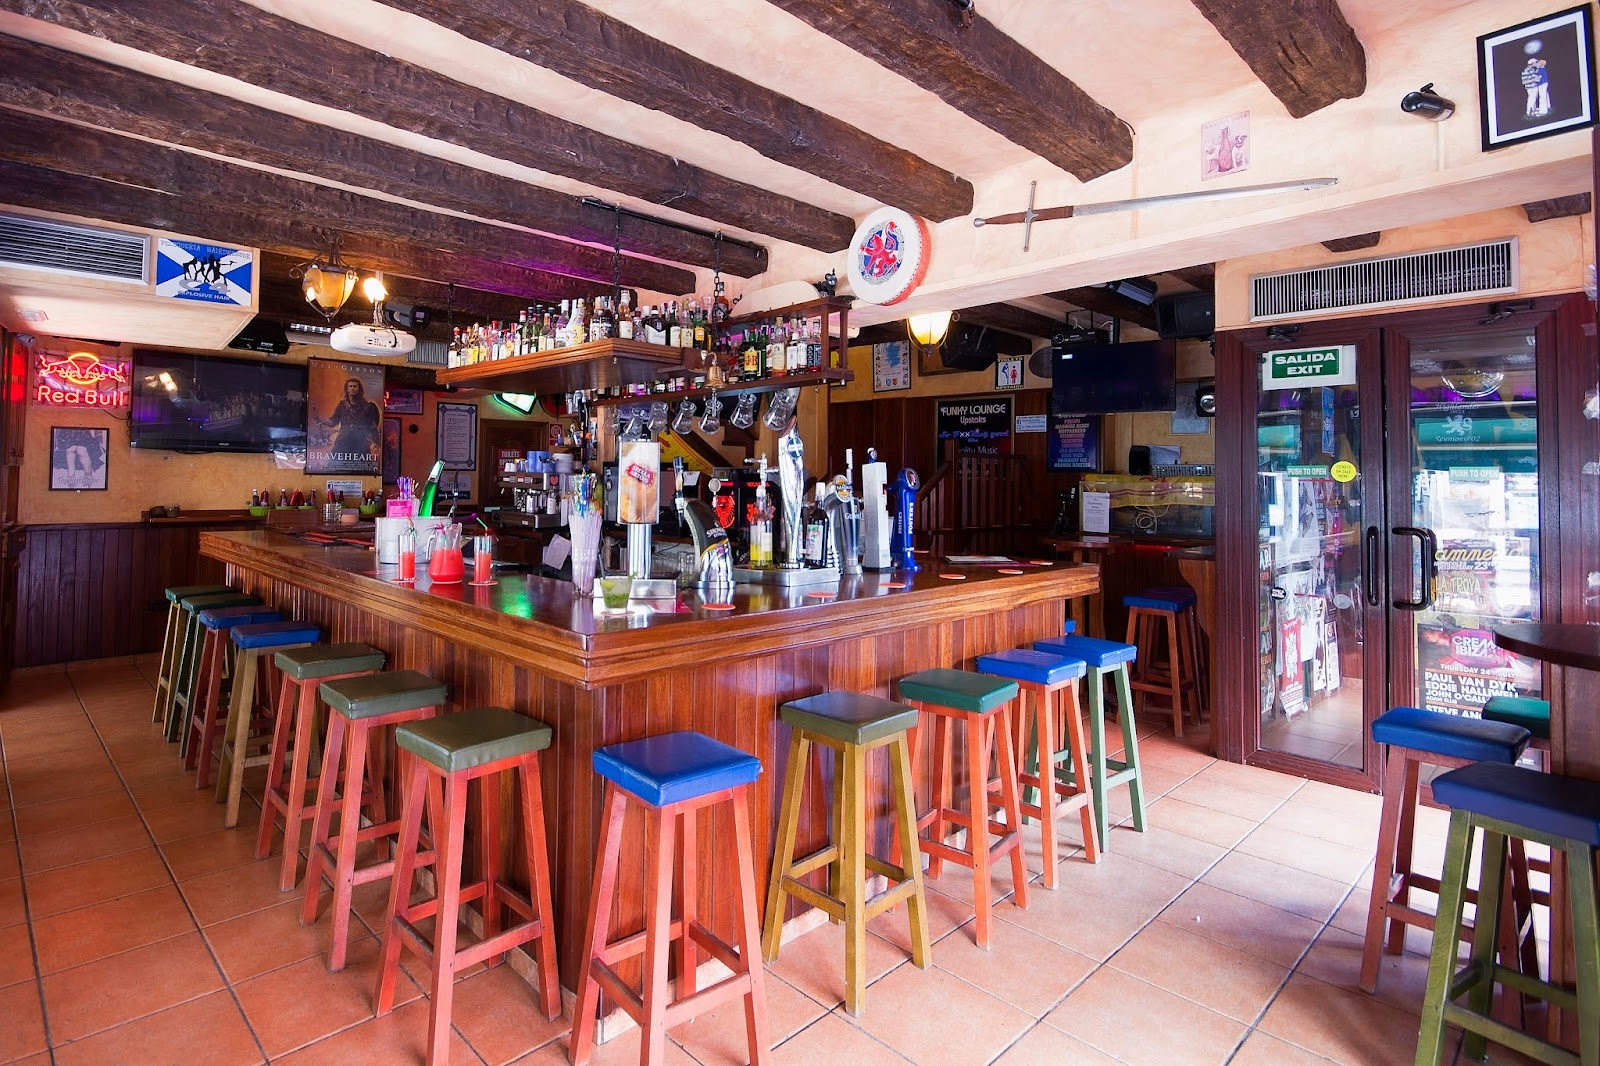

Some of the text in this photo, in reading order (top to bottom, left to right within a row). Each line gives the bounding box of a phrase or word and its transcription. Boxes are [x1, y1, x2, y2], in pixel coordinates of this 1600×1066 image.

[1275, 352, 1336, 365] SALIDA
[341, 364, 382, 374] GIBSON
[1287, 365, 1324, 375] EXIT
[38, 385, 124, 406] Red Bull
[942, 403, 1006, 416] FUNKY LOUNGE
[960, 416, 987, 426] Upstairs
[501, 450, 521, 458] TOILETS
[977, 445, 998, 455] Music
[309, 452, 379, 461] BRAVEHEART
[1287, 468, 1327, 476] PUSH TO OPEN
[1450, 469, 1499, 478] PUSH TO OPEN
[1451, 576, 1482, 593] TROYA
[1455, 644, 1488, 657] IBIZA
[1440, 663, 1479, 675] THURSDAY
[1425, 671, 1517, 692] PAUL VAN DYK
[1425, 681, 1457, 693] EDDIE
[1425, 689, 1452, 698] JOHN
